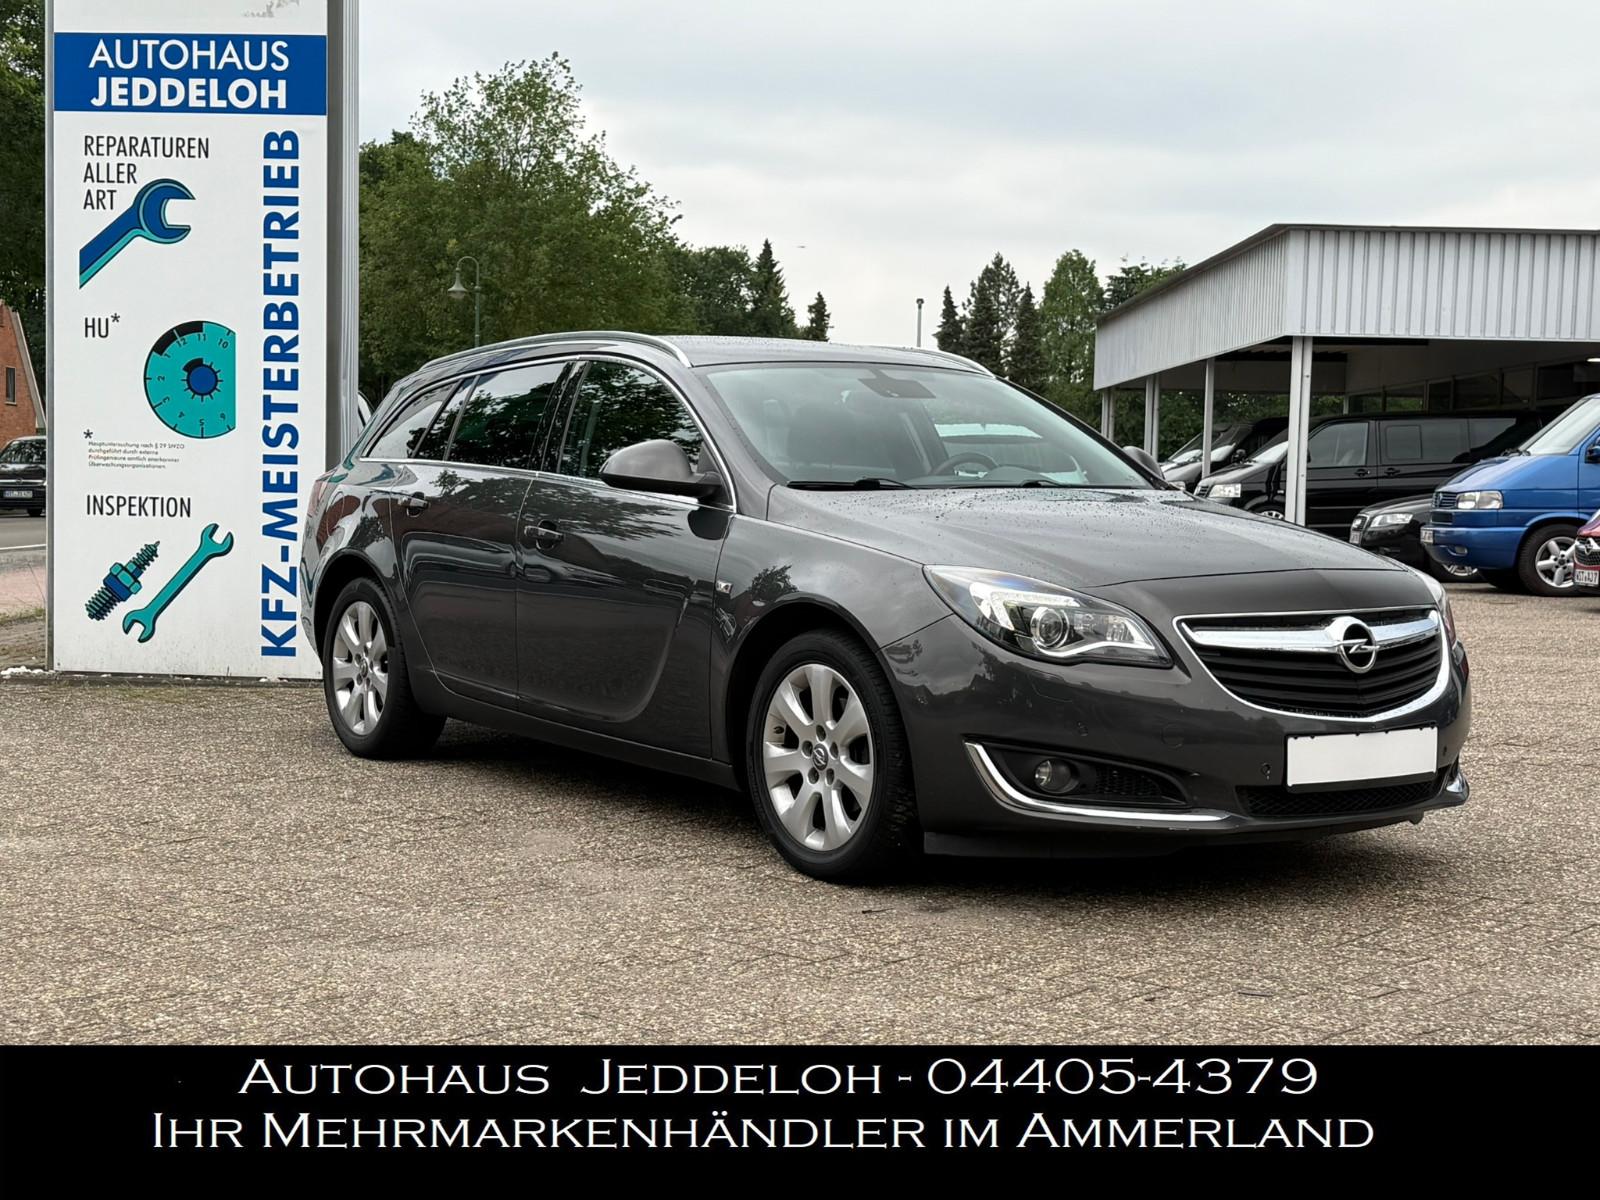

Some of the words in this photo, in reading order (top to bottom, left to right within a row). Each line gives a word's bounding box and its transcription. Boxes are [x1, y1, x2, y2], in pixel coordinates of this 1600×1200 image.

[88, 39, 289, 71] AUTOHAUS
[91, 77, 287, 109] JEDDELOH
[84, 135, 209, 158] REPARATUREN
[84, 163, 137, 184] ALLER
[84, 189, 117, 210] ART
[176, 338, 187, 347] 12
[218, 338, 229, 349] 10
[261, 130, 299, 657] KFZ-MEISTERBETRIEB
[86, 494, 191, 518] INSPEKTION
